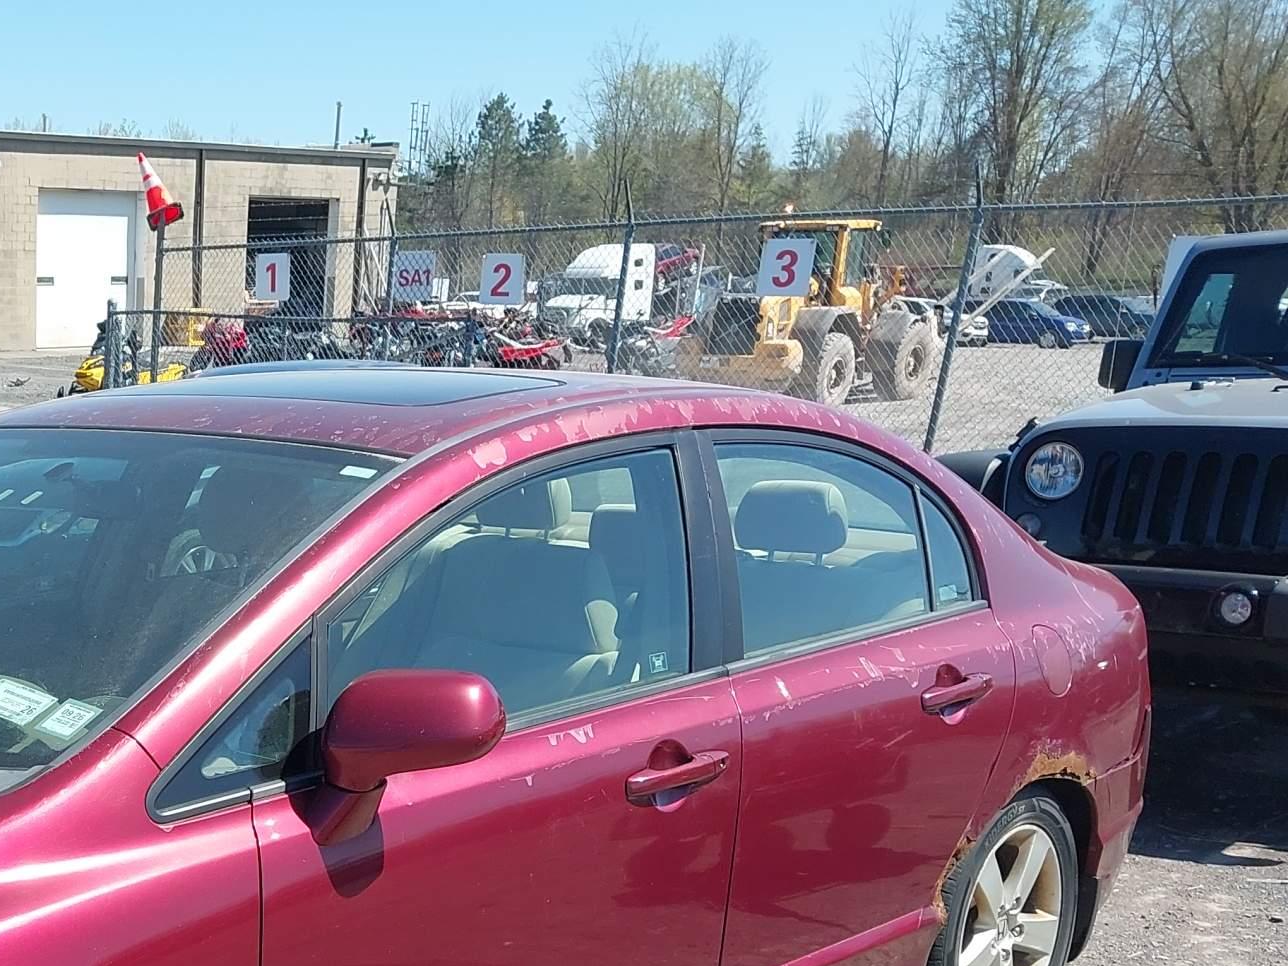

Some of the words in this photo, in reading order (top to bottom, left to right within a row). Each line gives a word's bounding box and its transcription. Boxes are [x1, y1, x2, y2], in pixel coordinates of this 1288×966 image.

[265, 262, 277, 293] 1
[397, 268, 432, 288] SA1
[490, 263, 512, 297] 2
[772, 249, 799, 288] 3
